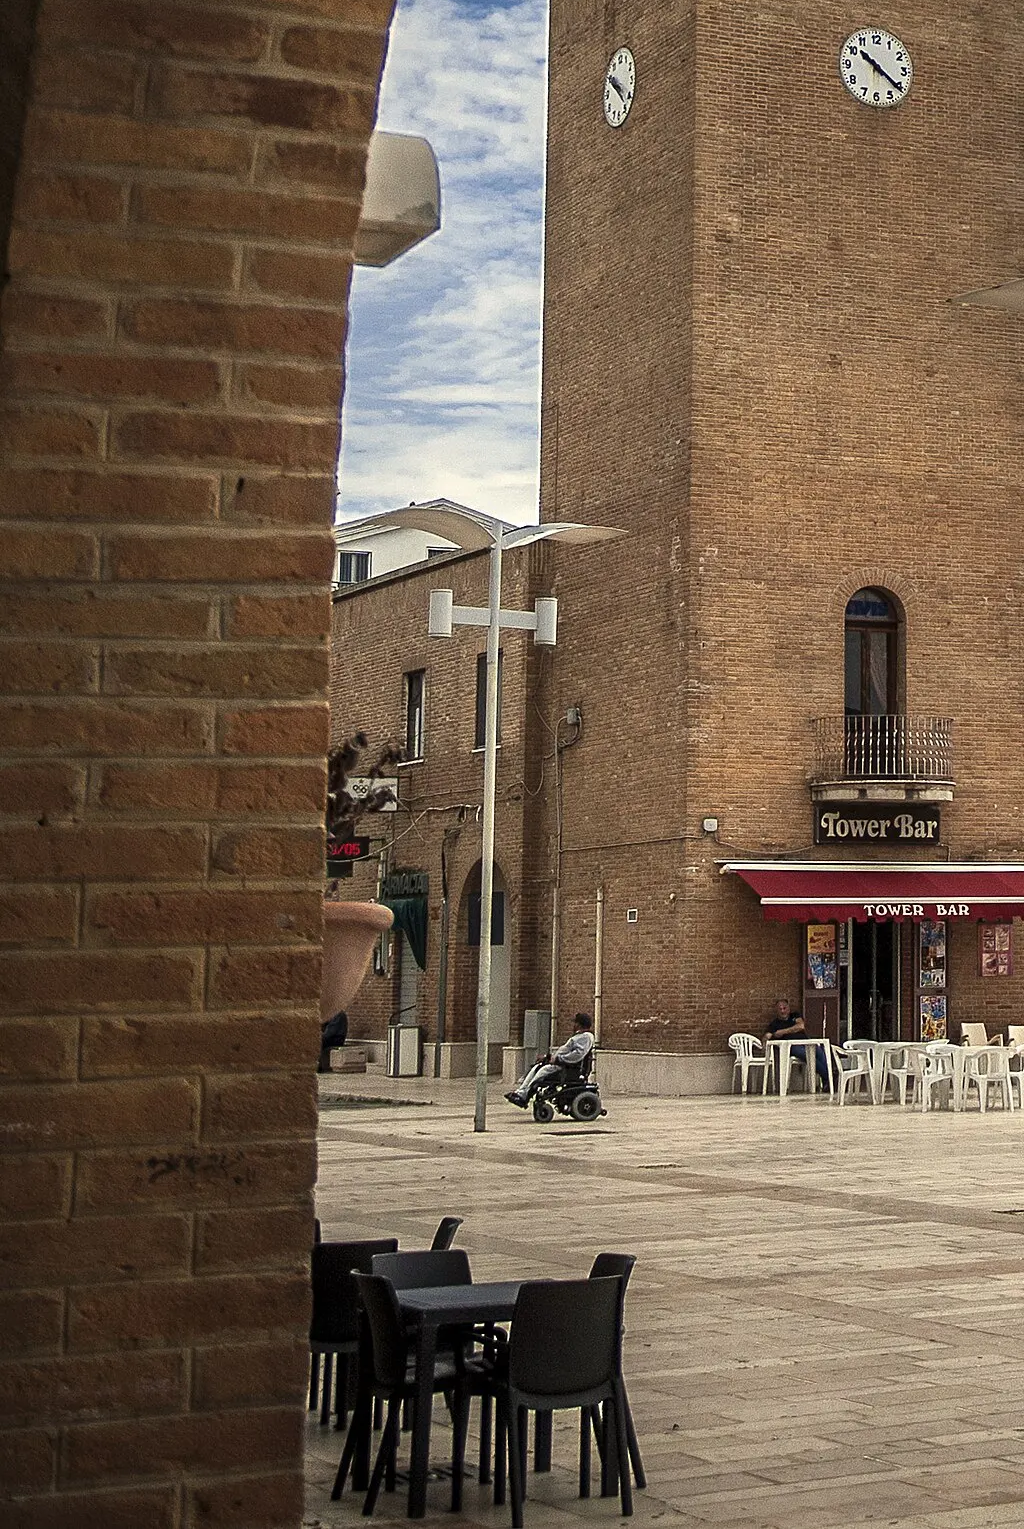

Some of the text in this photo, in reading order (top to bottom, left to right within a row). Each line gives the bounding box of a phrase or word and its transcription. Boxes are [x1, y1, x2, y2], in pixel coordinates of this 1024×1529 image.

[859, 37, 866, 46] 11
[872, 35, 882, 45] 12
[887, 41, 891, 50] 1
[849, 46, 858, 55] 10
[896, 52, 903, 61] 2
[845, 59, 852, 69] 9
[901, 67, 907, 76] 3
[849, 75, 856, 84] 8
[860, 87, 868, 96] 7
[886, 90, 894, 99] 5
[873, 92, 880, 101] 6
[820, 811, 938, 839] Tower Bar
[863, 904, 970, 917] TOWER BAR
